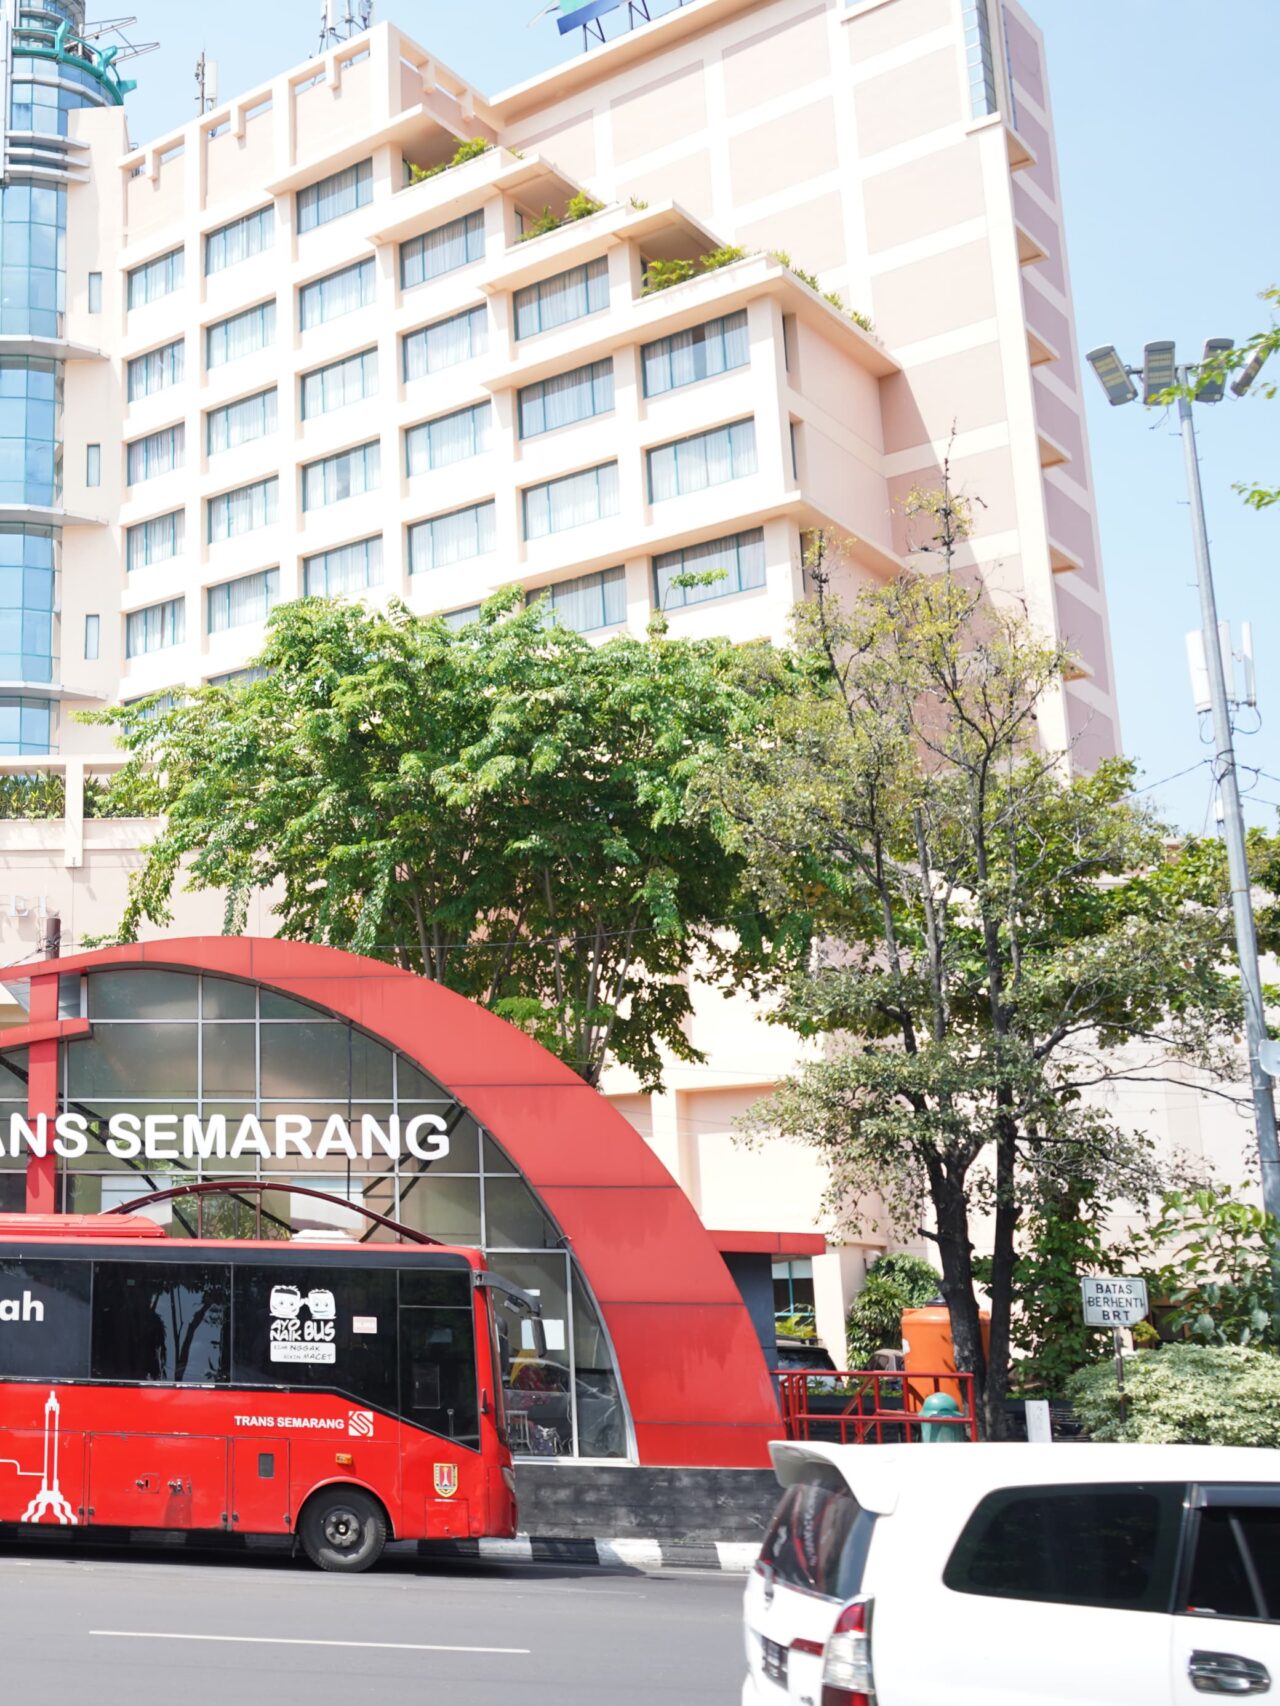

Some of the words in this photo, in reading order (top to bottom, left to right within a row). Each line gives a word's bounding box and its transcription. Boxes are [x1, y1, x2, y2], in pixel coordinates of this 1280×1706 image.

[106, 1113, 450, 1160] SEMARANG
[1095, 1283, 1132, 1294] BATAS
[1102, 1311, 1130, 1321] BRT
[269, 1329, 302, 1342] NAIK
[304, 1320, 336, 1342] BUS
[270, 1319, 301, 1331] AYO
[234, 1415, 274, 1427] TRANS
[277, 1417, 345, 1430] SEMARANG
